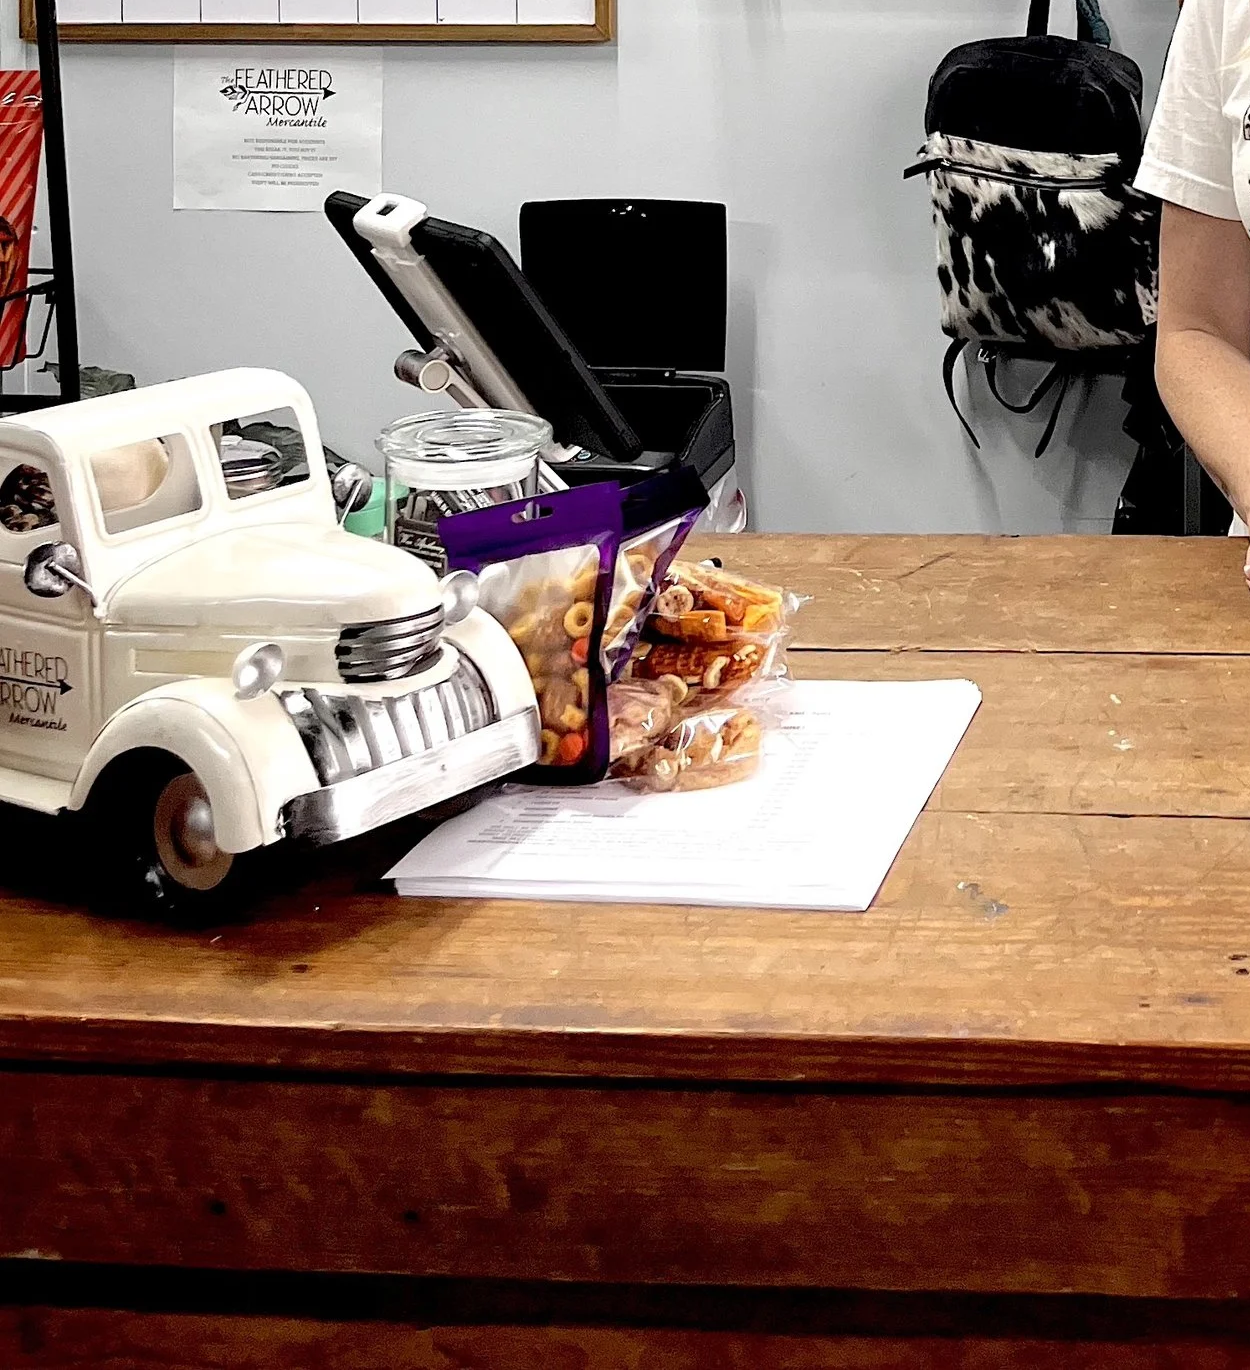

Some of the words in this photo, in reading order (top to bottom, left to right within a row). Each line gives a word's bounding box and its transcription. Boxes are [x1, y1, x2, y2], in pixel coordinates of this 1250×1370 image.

[235, 68, 333, 90] FEATHERED
[245, 95, 320, 117] ARROW
[266, 116, 328, 128] Mercantile
